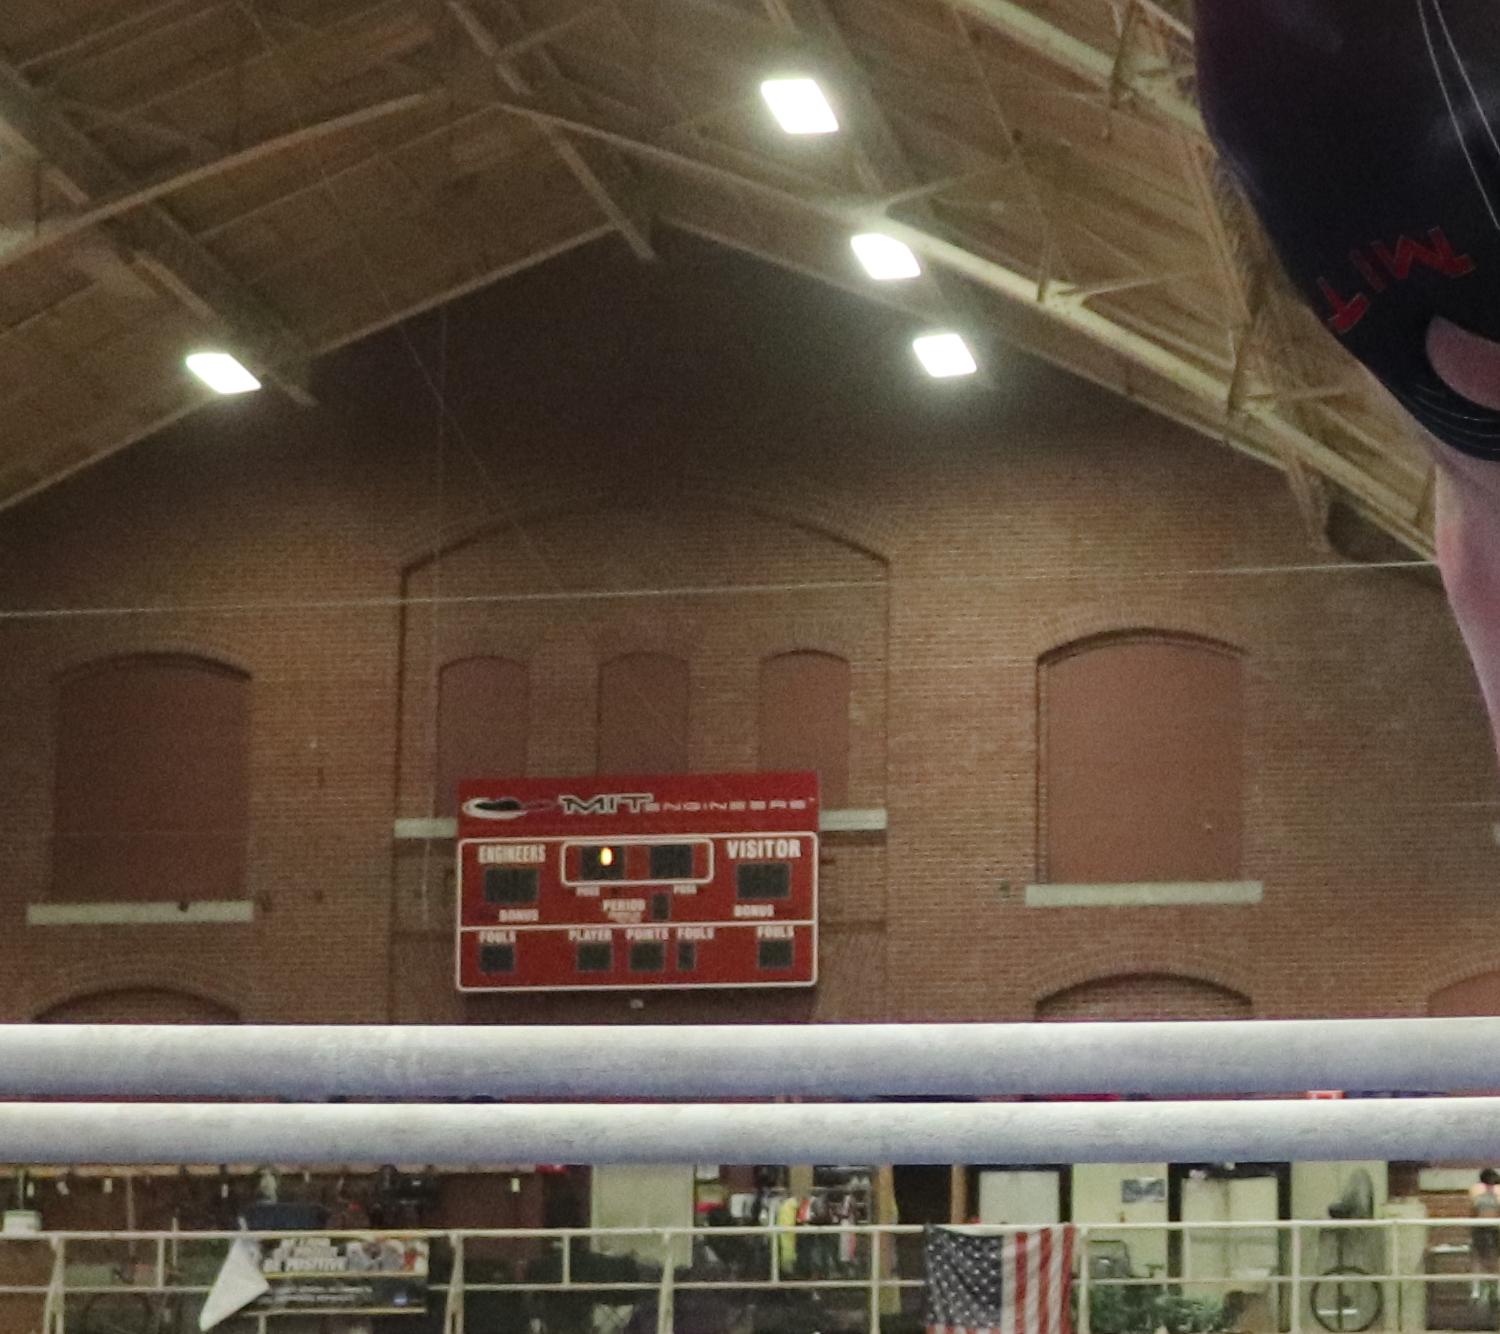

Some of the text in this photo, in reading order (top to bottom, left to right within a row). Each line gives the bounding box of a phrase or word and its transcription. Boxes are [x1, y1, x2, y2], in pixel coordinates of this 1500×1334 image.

[1316, 225, 1477, 333] MIT
[559, 793, 804, 816] MIT ENGINEERS
[478, 844, 546, 863] ENGINEERS
[727, 839, 801, 859] VISITOR
[602, 899, 647, 912] PERIOD
[734, 905, 774, 917] BONUS
[499, 909, 539, 922] BONUS
[479, 931, 516, 943] FOULS
[569, 929, 612, 941] PLAYER
[626, 928, 669, 940] POINTS
[677, 927, 714, 940] FOULS
[757, 925, 795, 938] FOULS
